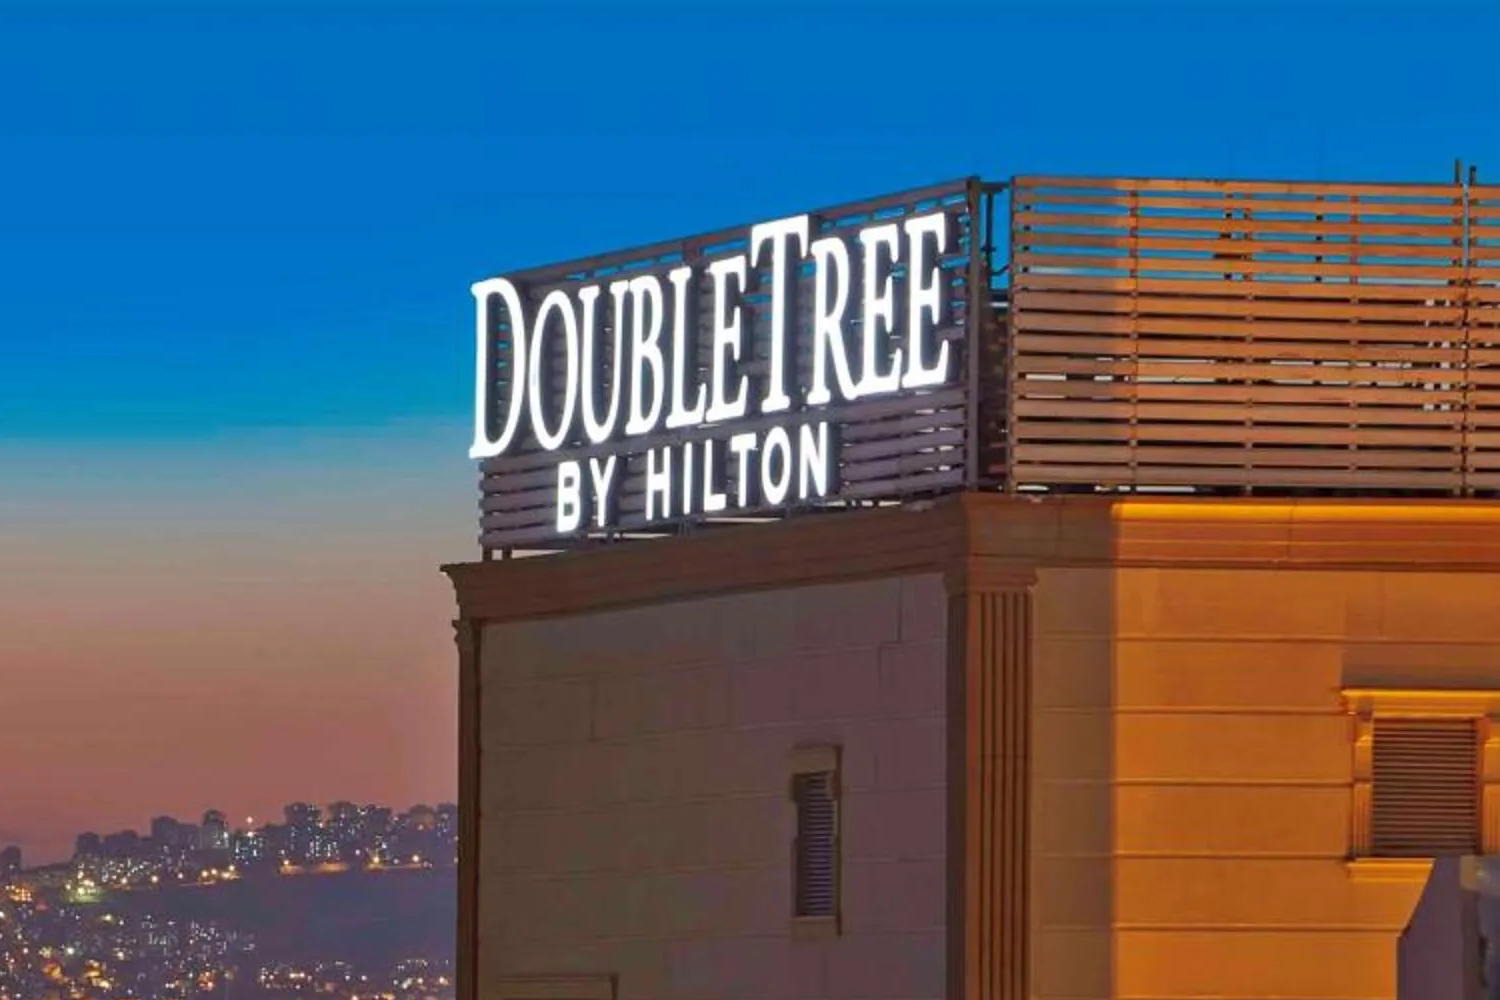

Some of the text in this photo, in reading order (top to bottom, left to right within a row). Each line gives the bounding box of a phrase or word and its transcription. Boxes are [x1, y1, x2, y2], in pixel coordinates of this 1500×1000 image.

[468, 212, 949, 459] DOUBLETREE
[556, 421, 828, 533] BY HILTON
